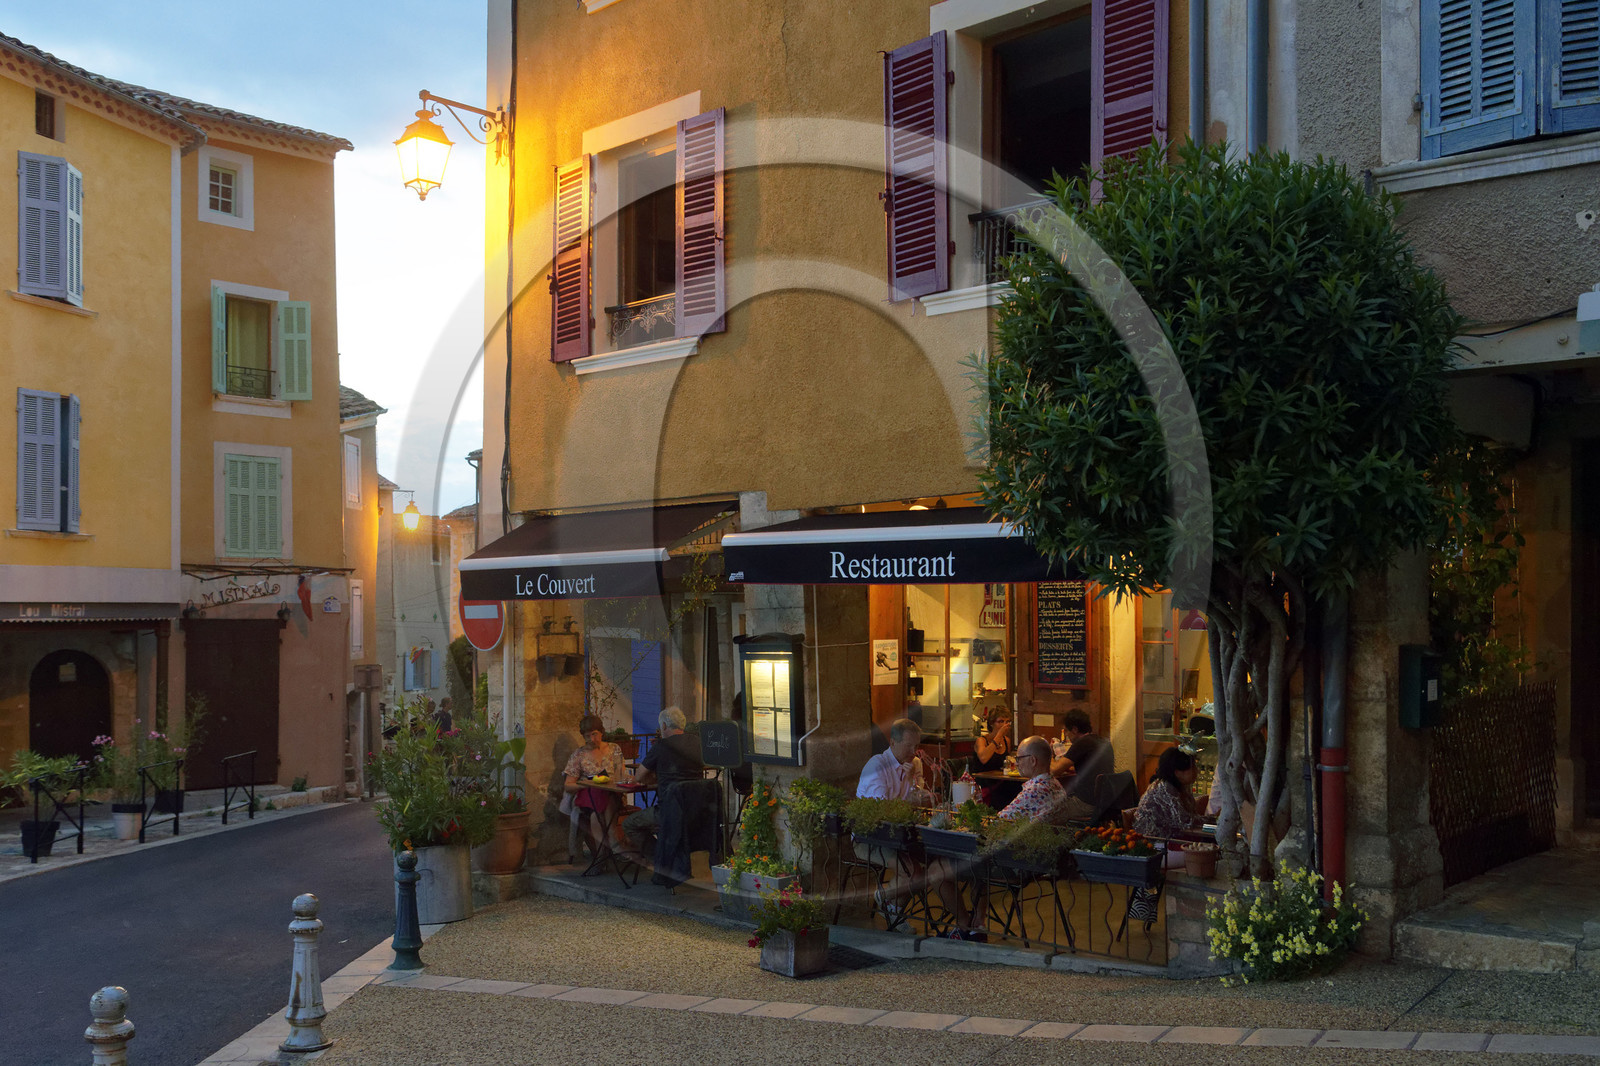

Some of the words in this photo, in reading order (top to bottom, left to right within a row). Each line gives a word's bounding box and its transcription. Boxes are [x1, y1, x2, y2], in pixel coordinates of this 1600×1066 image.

[829, 551, 956, 579] Restaurant
[515, 574, 534, 596] Le
[537, 573, 596, 596] Couvert
[19, 604, 40, 617] Lou
[51, 604, 86, 617] Mistral
[1038, 601, 1061, 609] PLATS
[1039, 642, 1074, 650] DESSERTS
